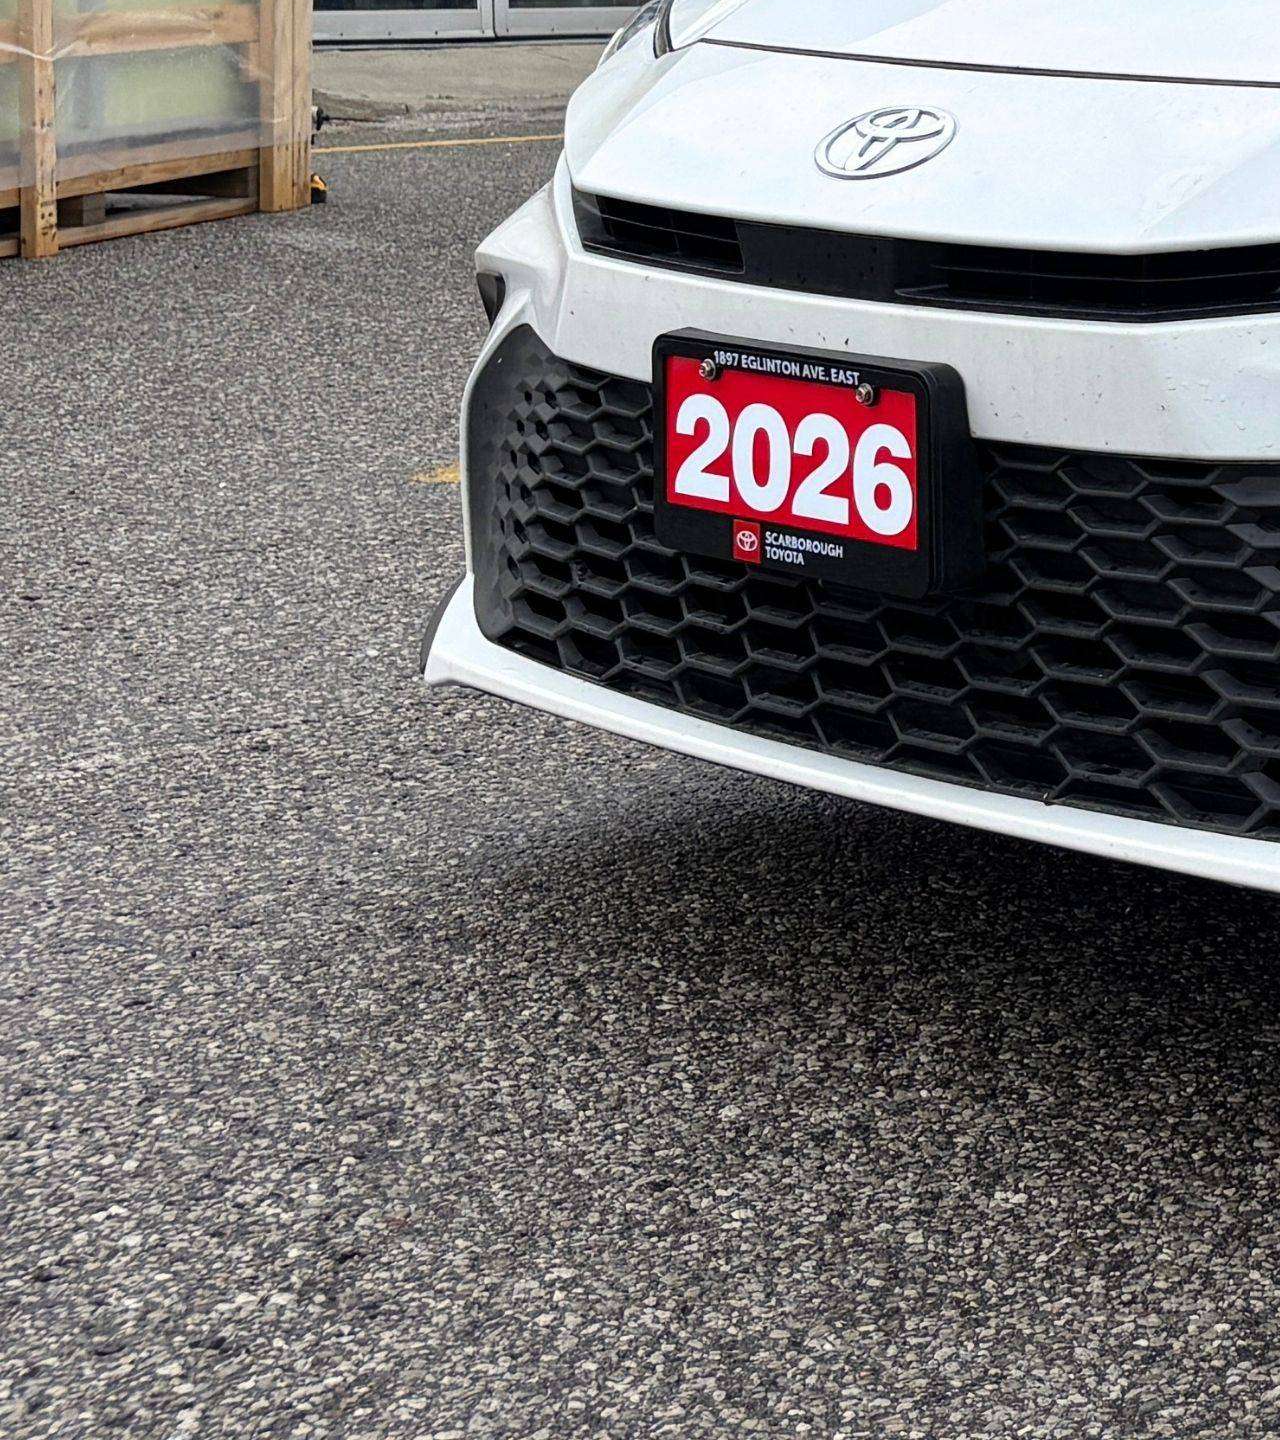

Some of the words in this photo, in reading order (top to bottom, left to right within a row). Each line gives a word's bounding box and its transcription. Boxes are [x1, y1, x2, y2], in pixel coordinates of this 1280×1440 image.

[714, 350, 739, 367] 1897
[741, 355, 800, 375] EGLINTON
[802, 364, 829, 381] AVE.
[831, 368, 860, 385] EAST
[674, 393, 913, 536] 2026
[765, 531, 844, 558] SCARBOROUGH
[765, 546, 805, 565] TOYOTA
